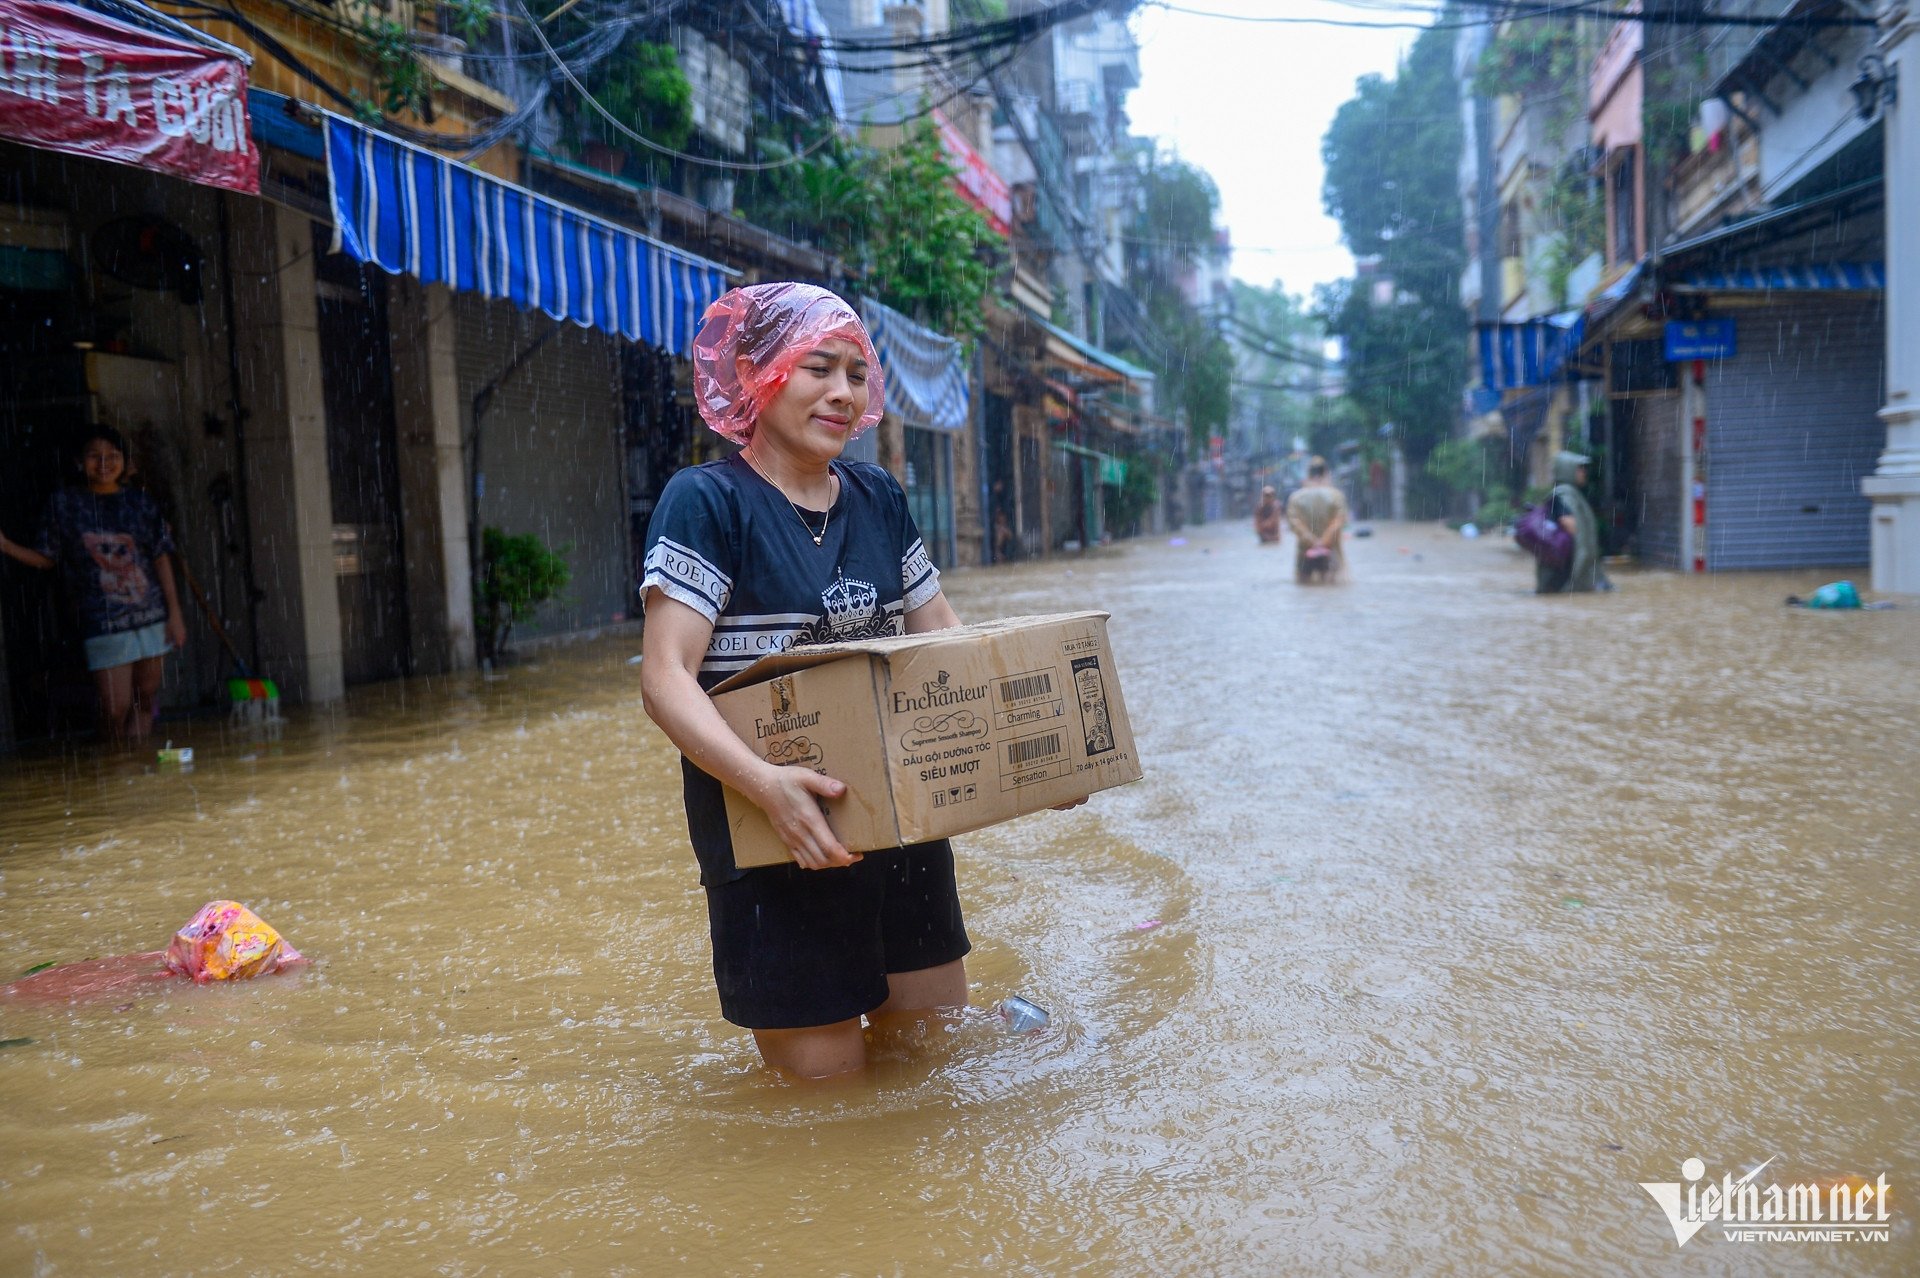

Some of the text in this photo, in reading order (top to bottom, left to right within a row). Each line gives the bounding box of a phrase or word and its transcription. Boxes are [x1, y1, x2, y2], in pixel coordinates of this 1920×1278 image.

[664, 552, 706, 586] ROEI
[893, 682, 988, 714] Enchanteur
[755, 709, 821, 739] Enchanteur
[1007, 709, 1041, 723] Charming
[920, 759, 981, 782] SIÊU MƯỢT
[1012, 770, 1048, 785] Sensation
